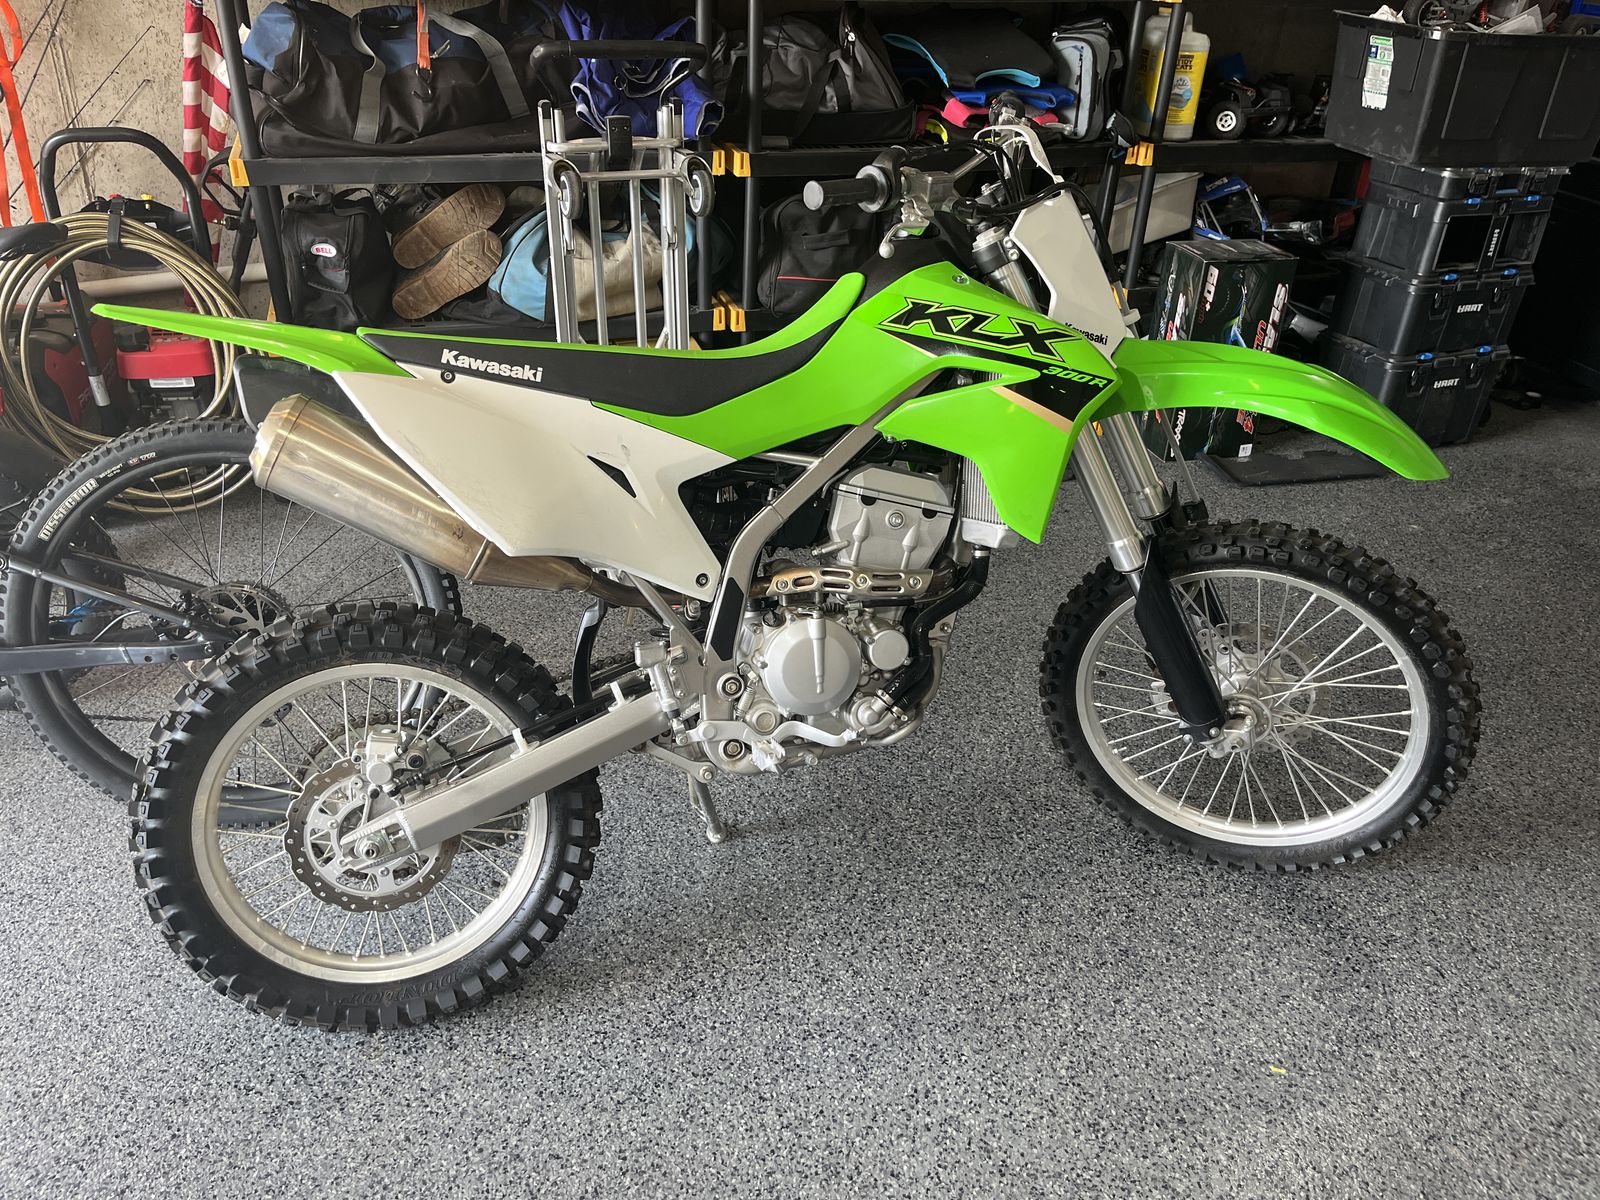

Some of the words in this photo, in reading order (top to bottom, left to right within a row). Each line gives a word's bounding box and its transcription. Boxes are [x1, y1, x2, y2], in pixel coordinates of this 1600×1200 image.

[1456, 303, 1484, 314] HART
[879, 297, 1083, 363] KLX
[440, 348, 544, 383] Kawasaki
[1433, 377, 1460, 389] HART
[38, 478, 99, 541] DISSECTOR
